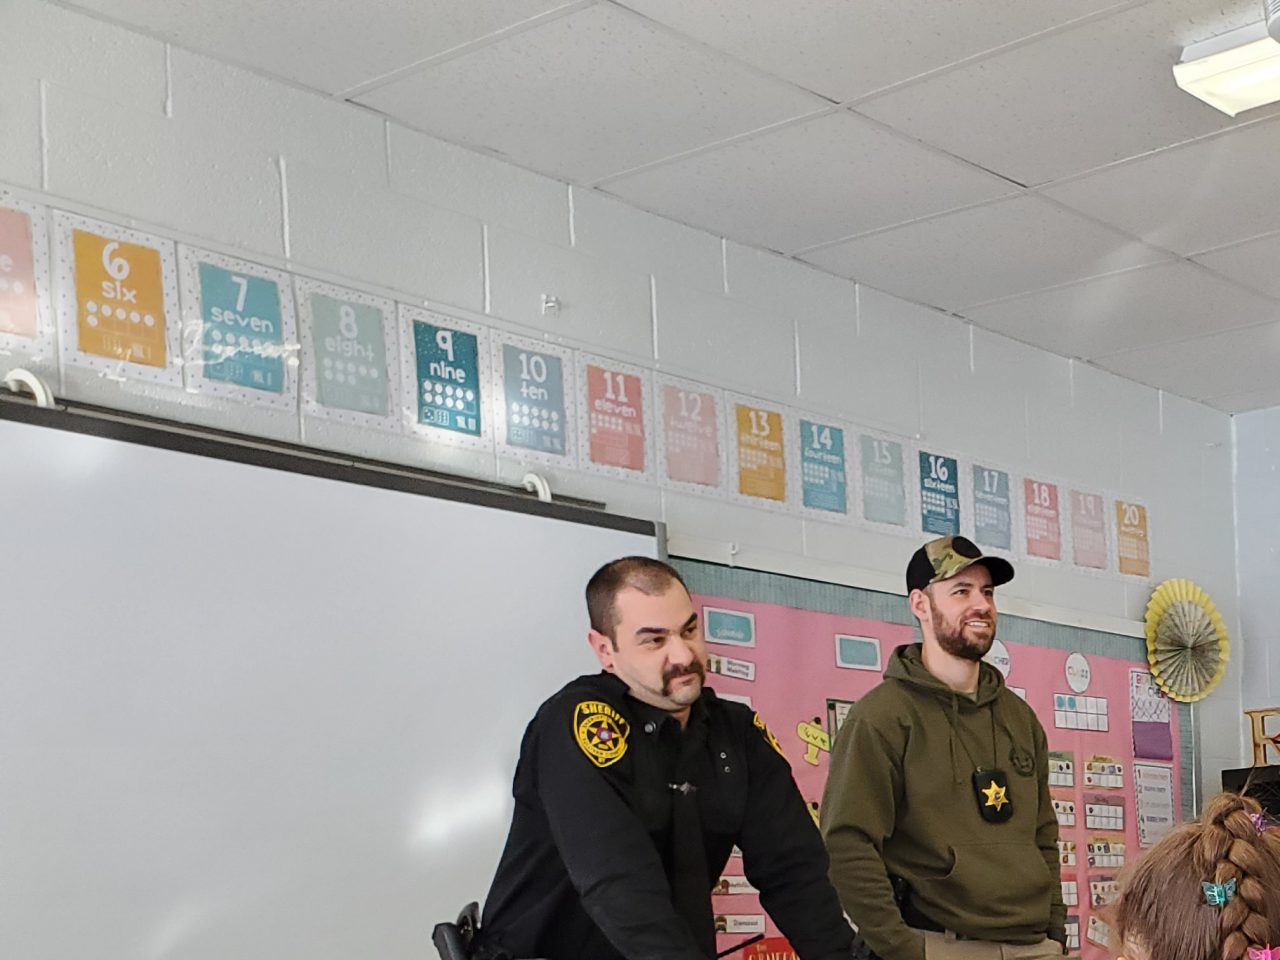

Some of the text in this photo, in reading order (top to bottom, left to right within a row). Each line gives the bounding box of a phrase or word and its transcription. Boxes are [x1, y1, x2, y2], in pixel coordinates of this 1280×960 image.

[102, 242, 130, 281] 6
[101, 280, 137, 304] six
[231, 275, 249, 312] 7
[210, 305, 274, 333] seven
[339, 304, 359, 339] 8
[324, 335, 375, 362] eight
[435, 329, 454, 361] 9
[429, 360, 466, 383] nine
[518, 352, 548, 383] 10
[519, 381, 548, 401] ten
[602, 371, 629, 402] 11
[594, 399, 637, 418] eleven
[678, 390, 702, 421] 12
[749, 410, 770, 437] 13
[810, 424, 833, 450] 14
[872, 441, 892, 464] 15
[928, 456, 949, 481] 16
[983, 469, 999, 493] 17
[1031, 482, 1051, 507] 18
[1078, 494, 1095, 516] 19
[1121, 503, 1140, 526] 20
[580, 703, 625, 725] SHERIFF
